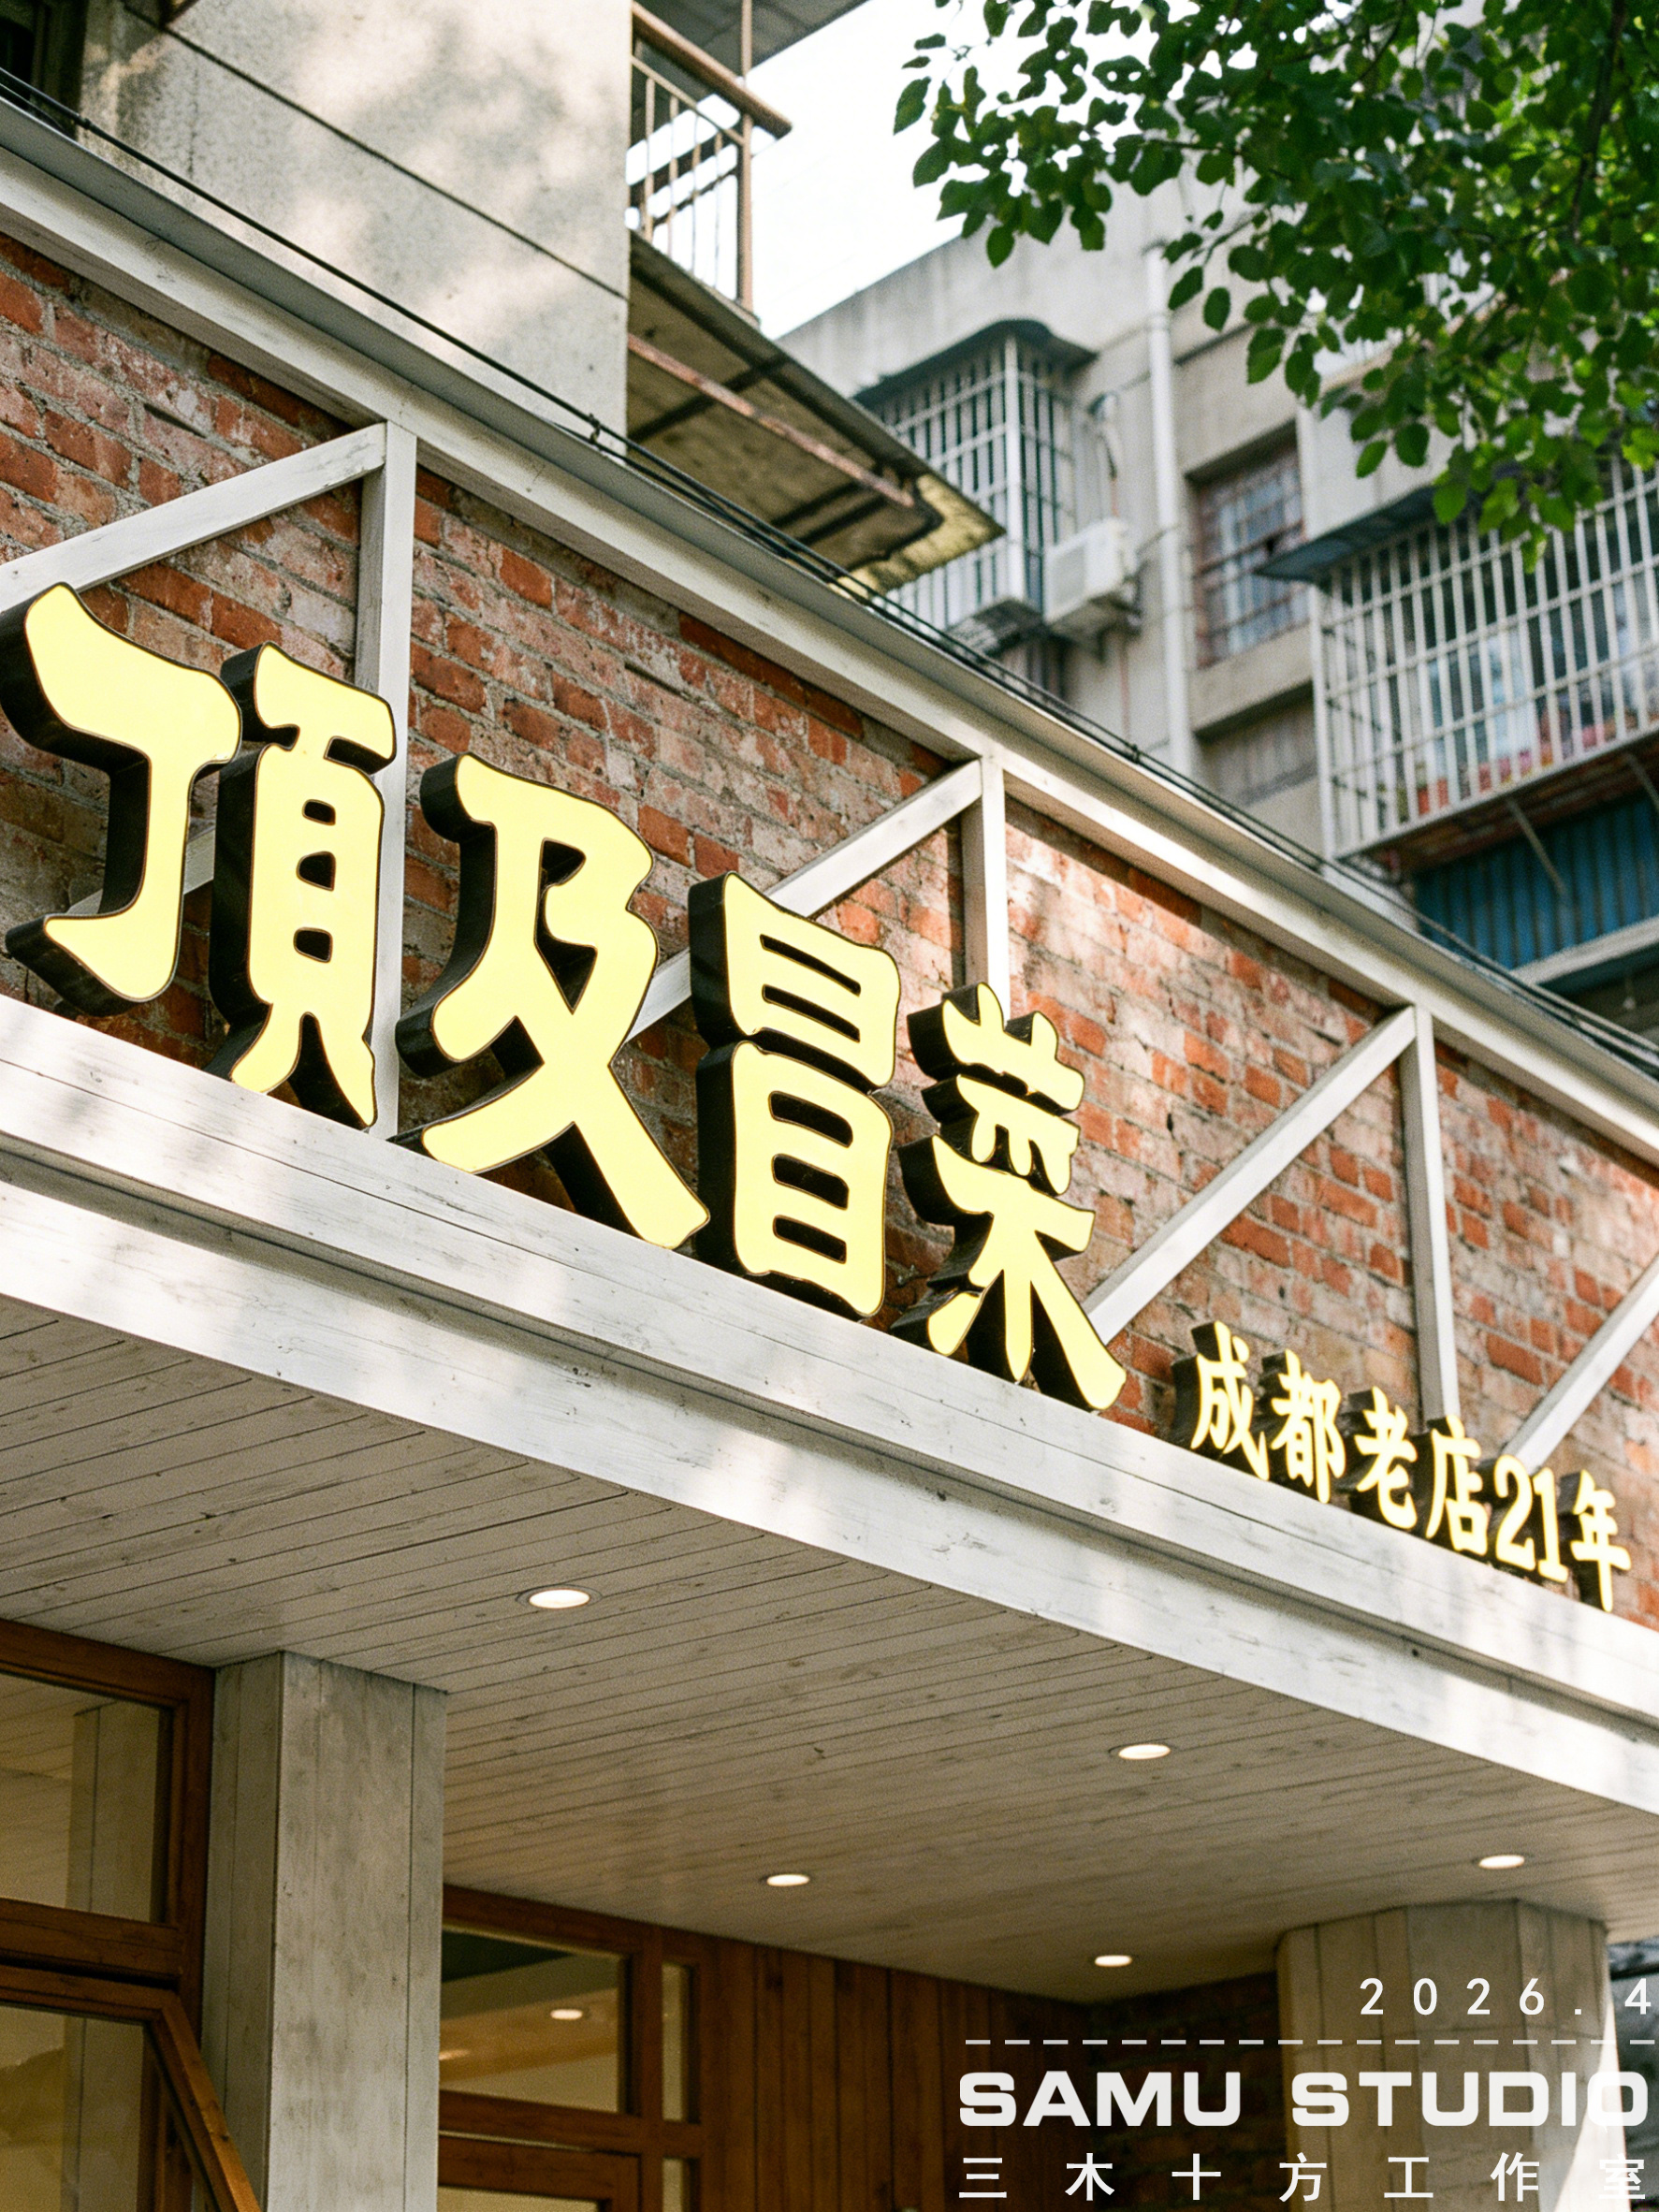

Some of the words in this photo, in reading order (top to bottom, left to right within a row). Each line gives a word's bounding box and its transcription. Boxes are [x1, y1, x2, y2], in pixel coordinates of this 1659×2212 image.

[22, 581, 1127, 1411] 頂及冒菜
[1190, 1320, 1632, 1612] 成都老店21年
